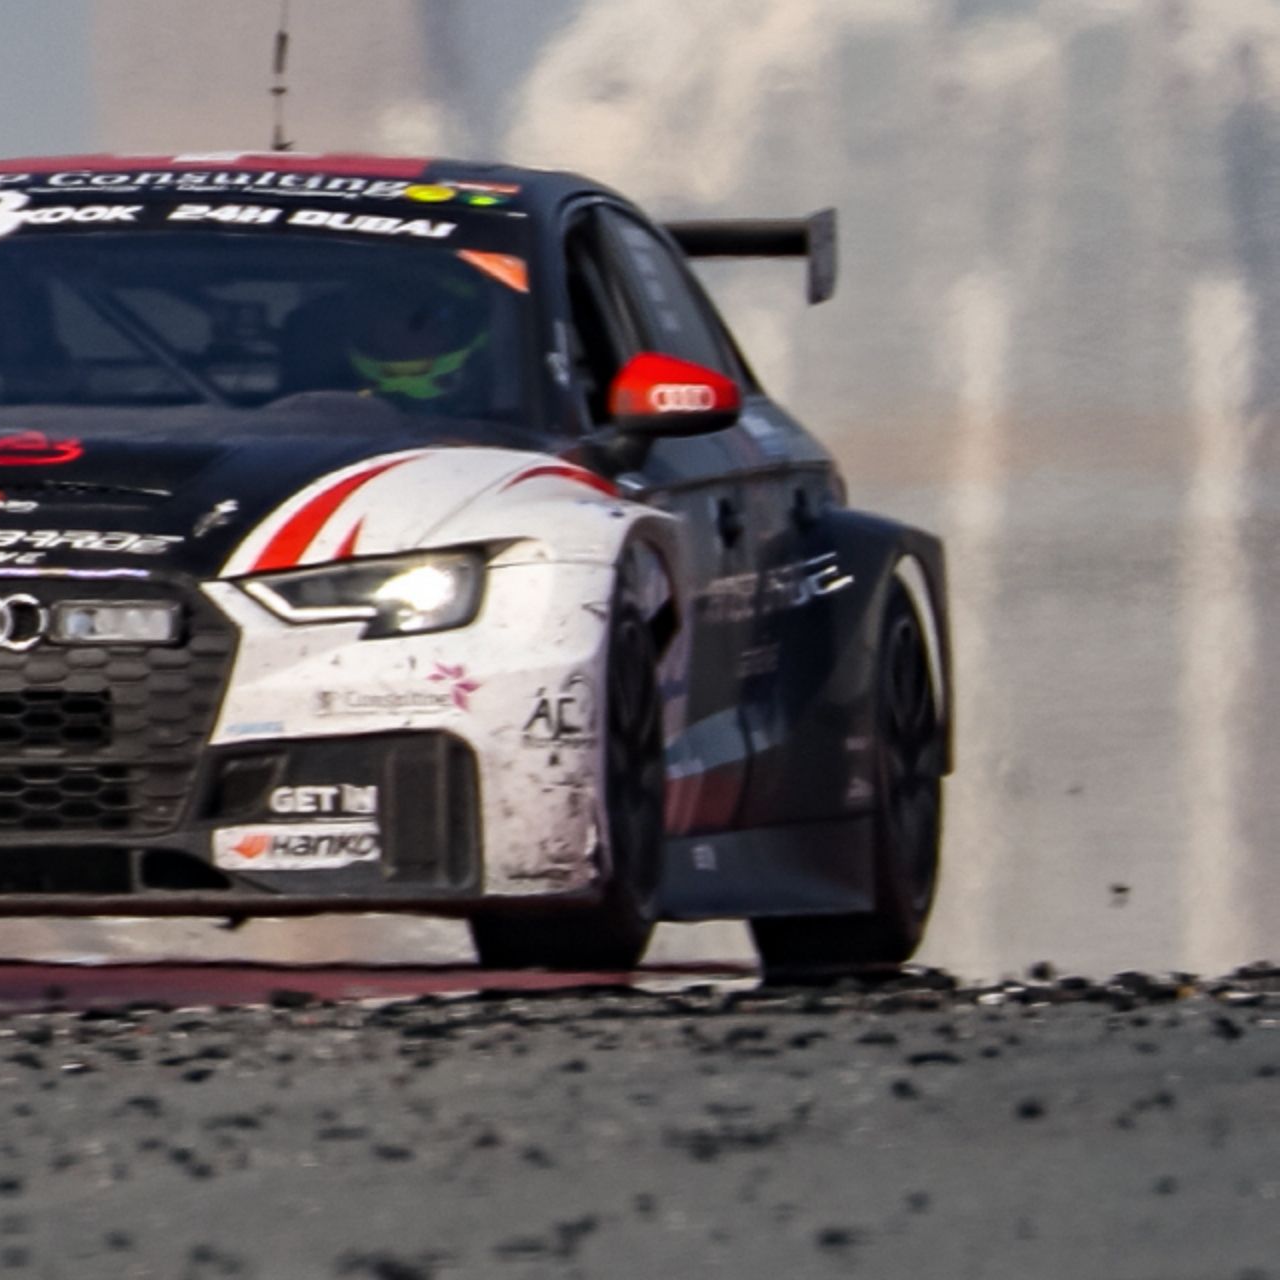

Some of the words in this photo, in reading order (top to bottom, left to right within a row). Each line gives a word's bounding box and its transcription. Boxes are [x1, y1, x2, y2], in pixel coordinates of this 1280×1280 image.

[46, 168, 415, 200] Consulting
[16, 205, 144, 224] KOOK
[166, 204, 285, 224] 24H
[286, 209, 458, 238] DUBAI
[270, 785, 339, 813] GET
[271, 834, 378, 856] HANKO
